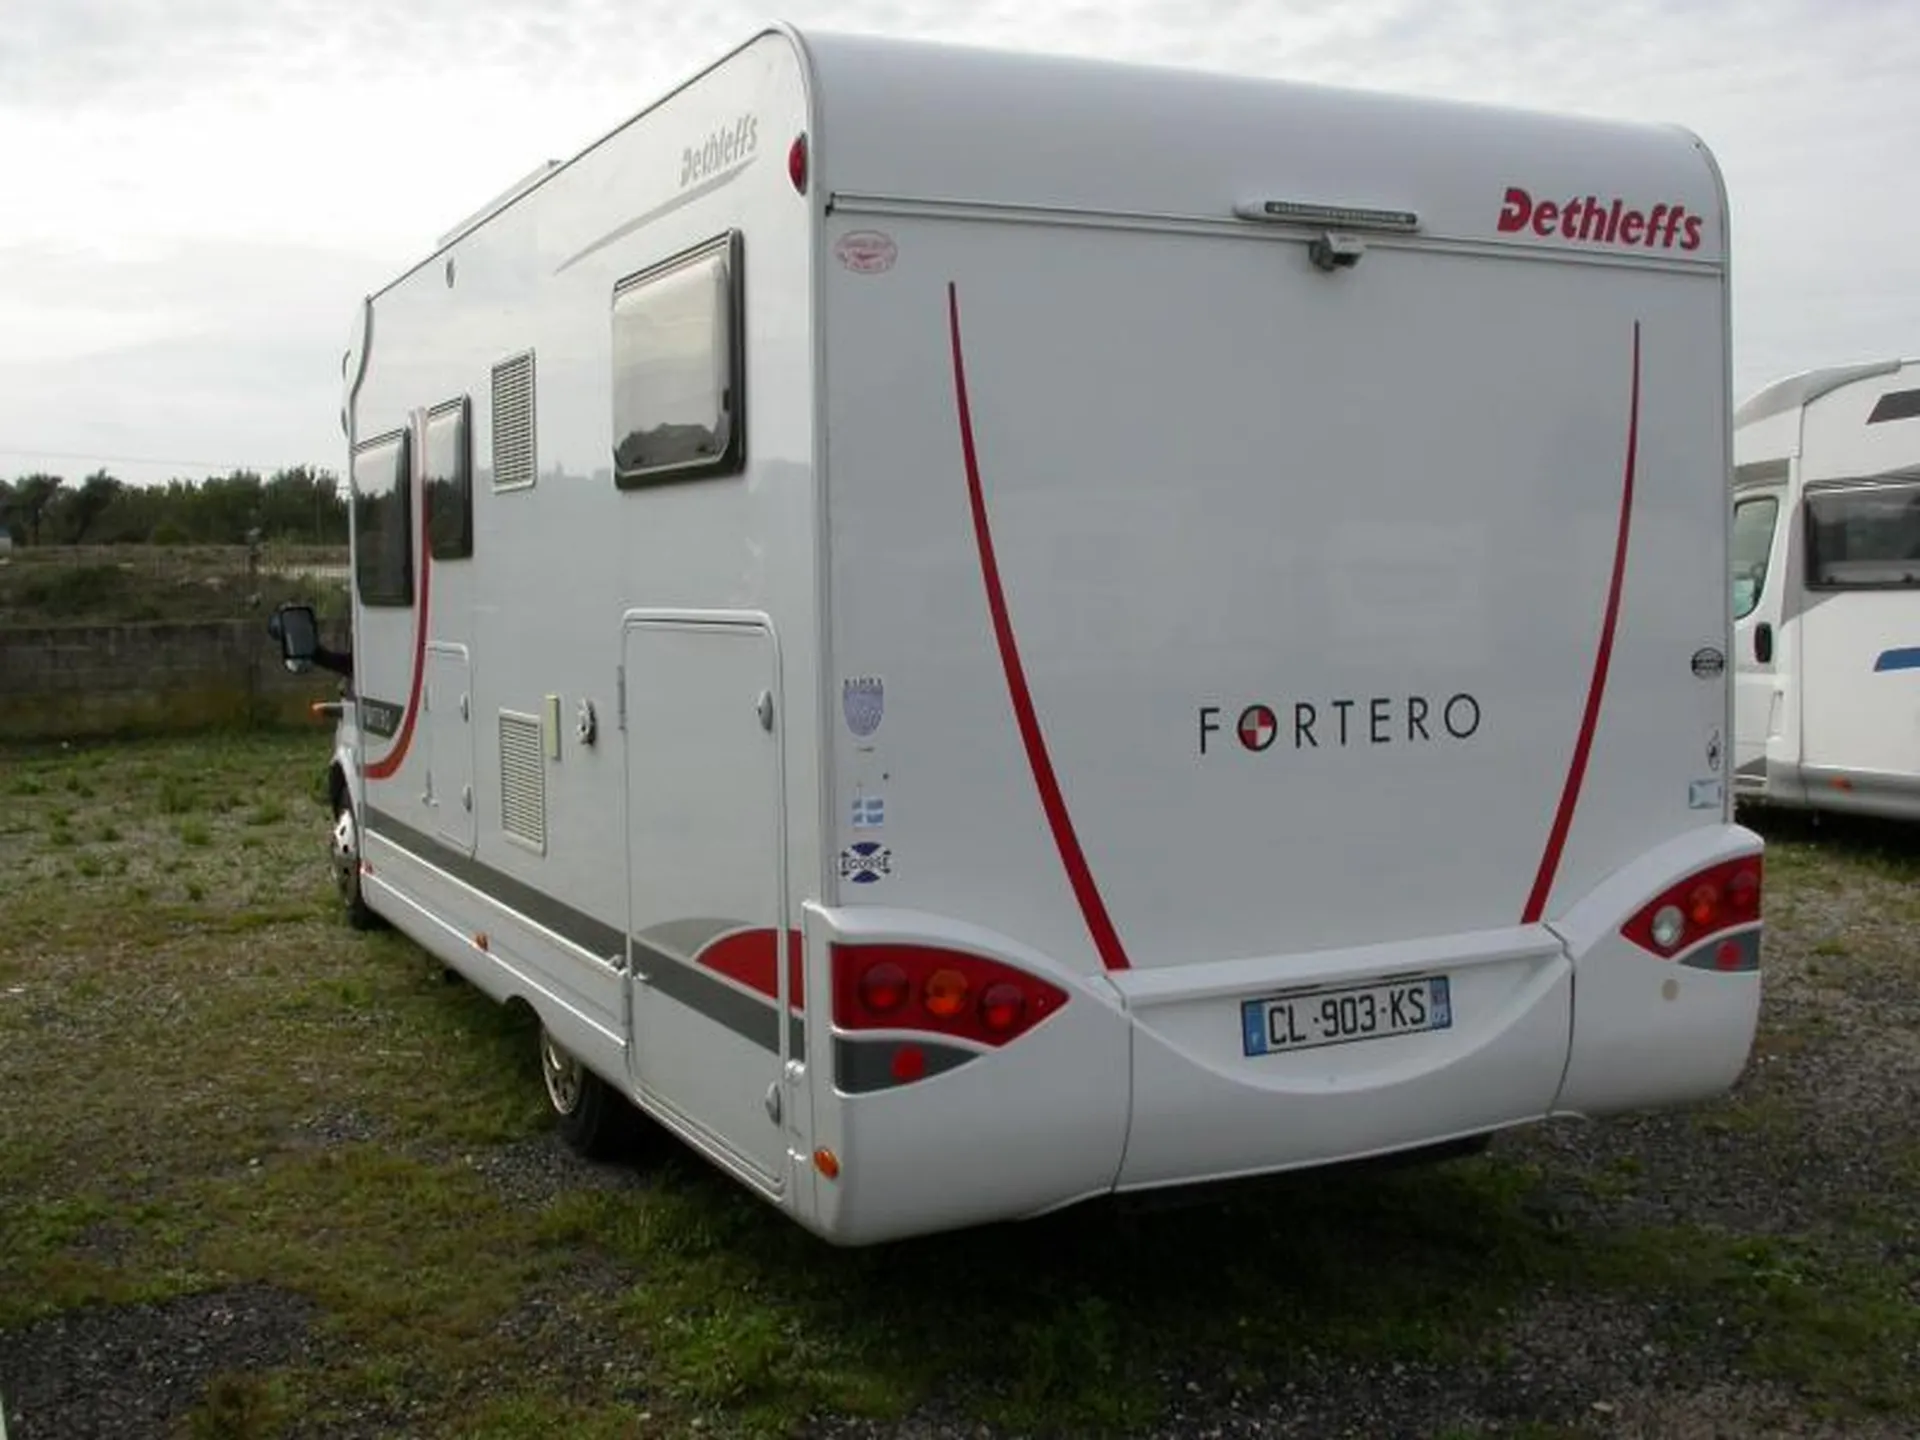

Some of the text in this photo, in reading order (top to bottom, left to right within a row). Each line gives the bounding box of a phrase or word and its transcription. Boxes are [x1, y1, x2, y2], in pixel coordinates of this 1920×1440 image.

[680, 114, 758, 188] Dethleffs
[1497, 187, 1703, 251] Dethleffs
[1199, 693, 1481, 755] FORTERO
